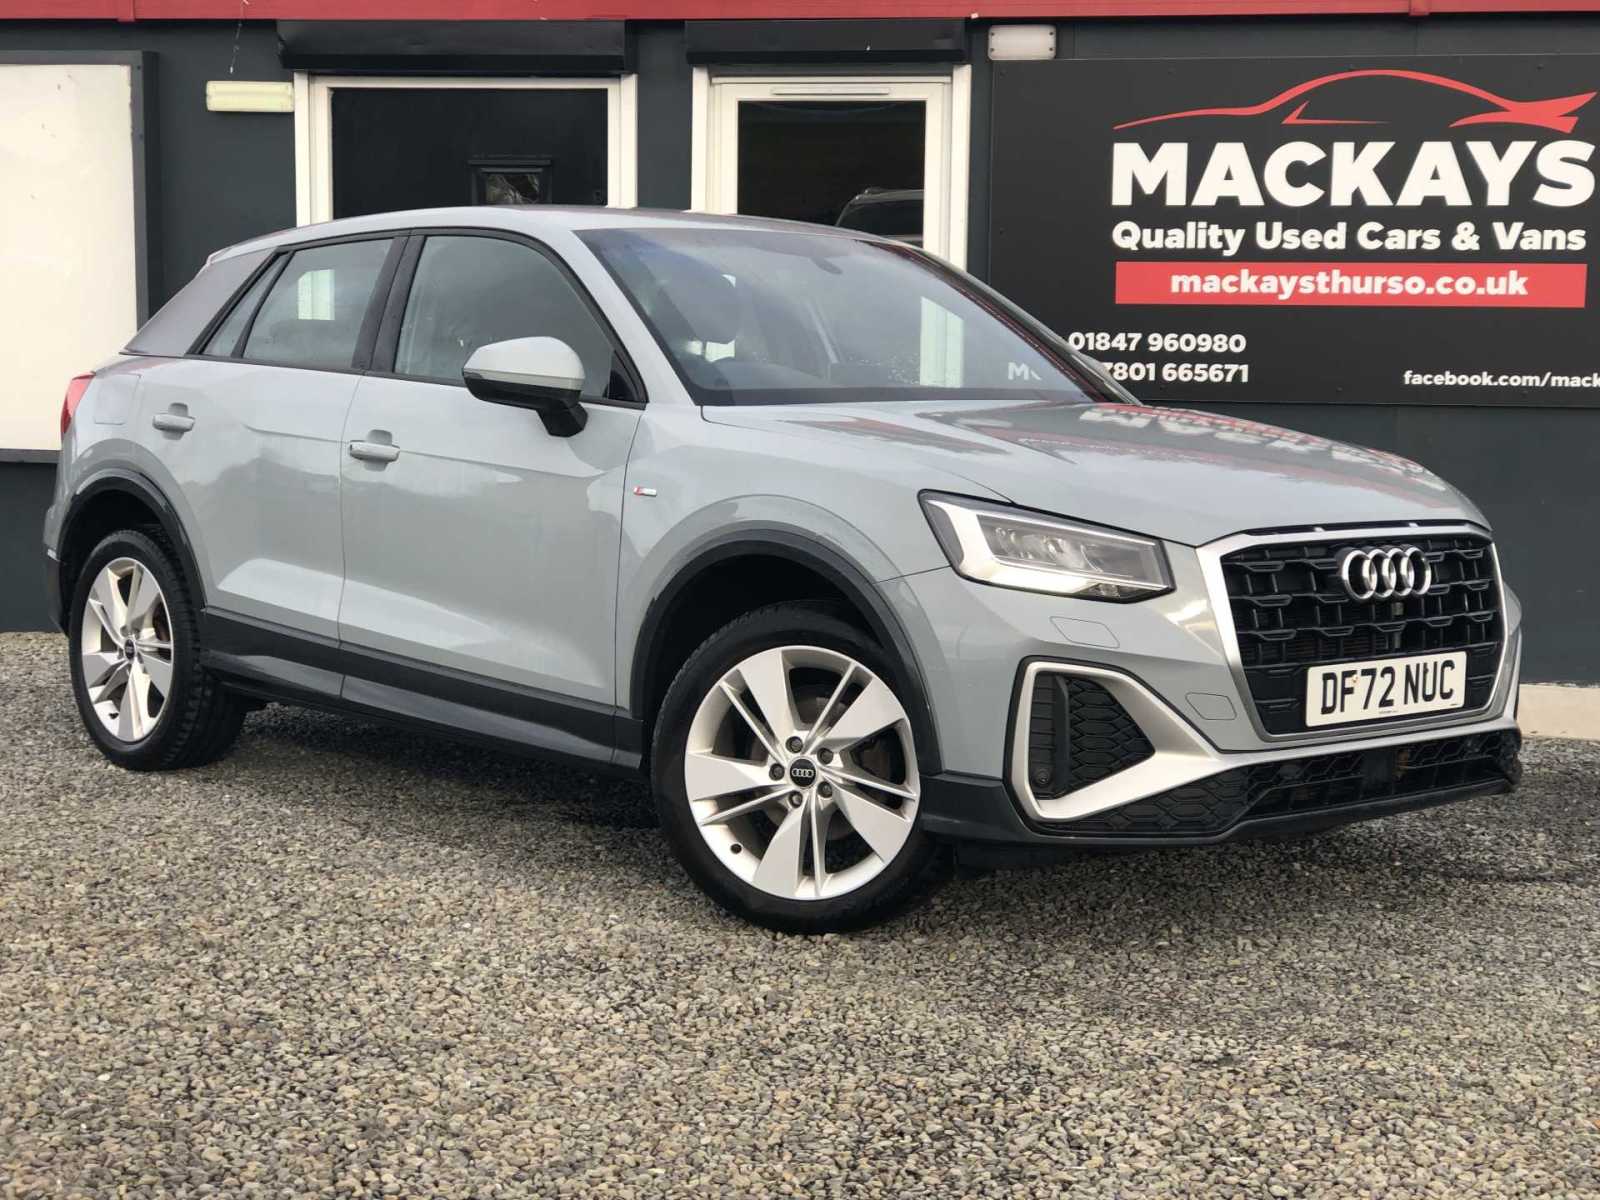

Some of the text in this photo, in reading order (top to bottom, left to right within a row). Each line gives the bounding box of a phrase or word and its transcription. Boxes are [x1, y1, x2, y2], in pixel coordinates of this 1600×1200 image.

[1111, 140, 1596, 207] MACKAYS
[1111, 221, 1587, 257] Quality Used Cars & Vans
[1171, 268, 1529, 300] mackaysthurso.co.uk
[1068, 331, 1247, 353] 01847 960980
[1162, 363, 1249, 383] 665671
[1321, 660, 1455, 715] DF72 NUC
